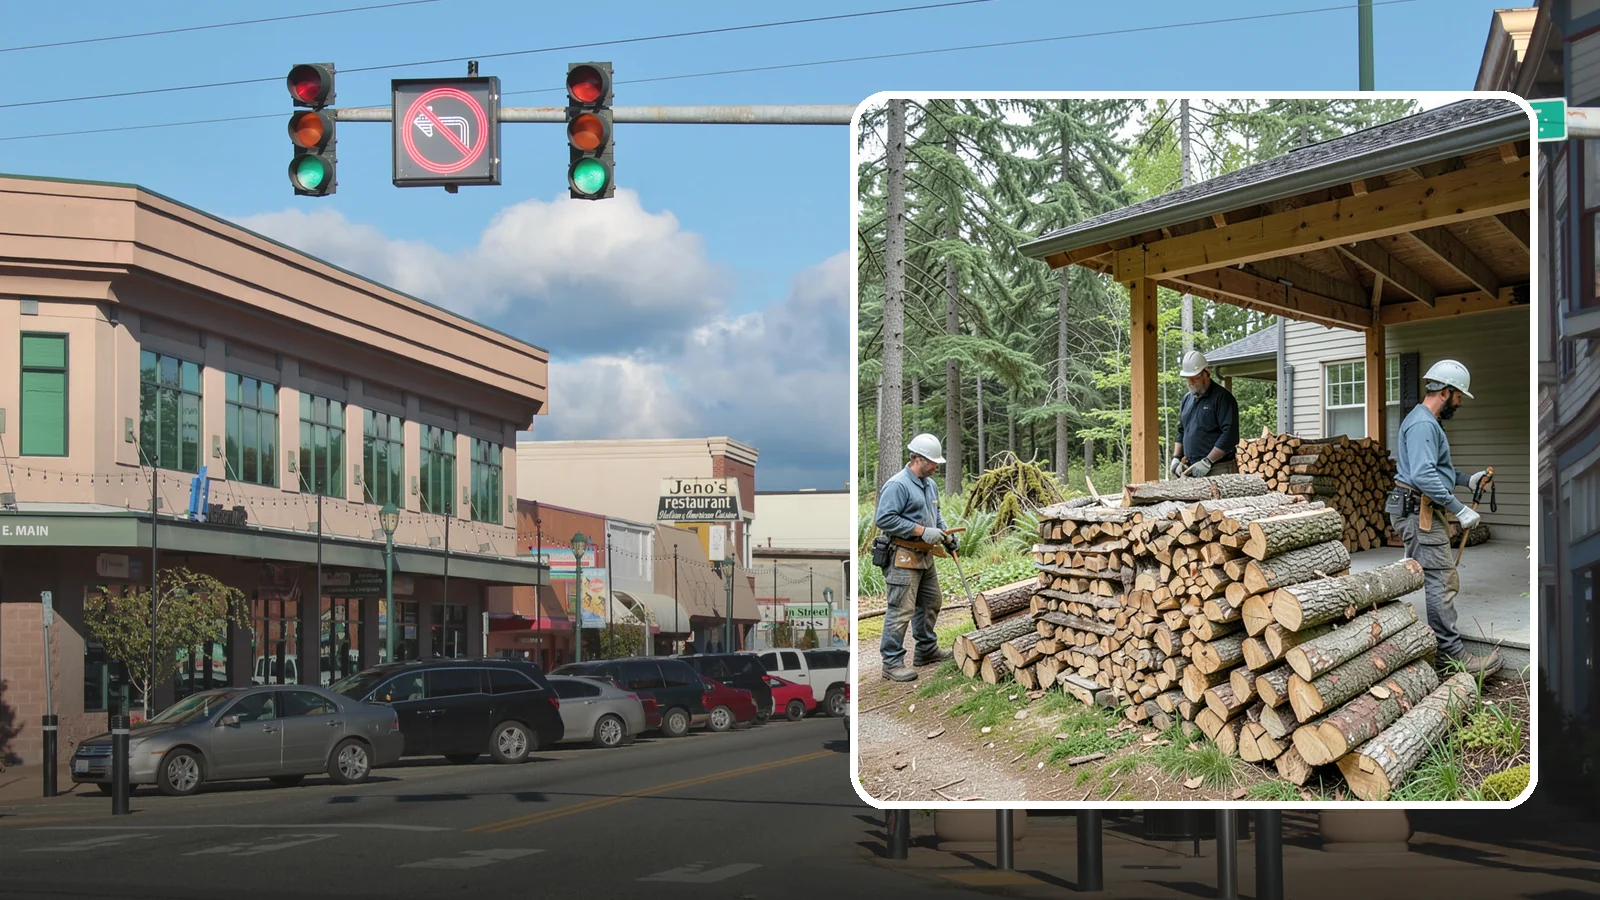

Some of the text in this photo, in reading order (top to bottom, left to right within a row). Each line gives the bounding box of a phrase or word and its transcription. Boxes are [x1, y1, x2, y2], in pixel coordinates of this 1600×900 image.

[670, 480, 728, 494] Jeno's
[665, 496, 731, 509] restaurant
[686, 510, 715, 519] American
[715, 510, 737, 518] Cuisine
[2, 525, 49, 536] E. MAIN
[797, 608, 829, 616] Street
